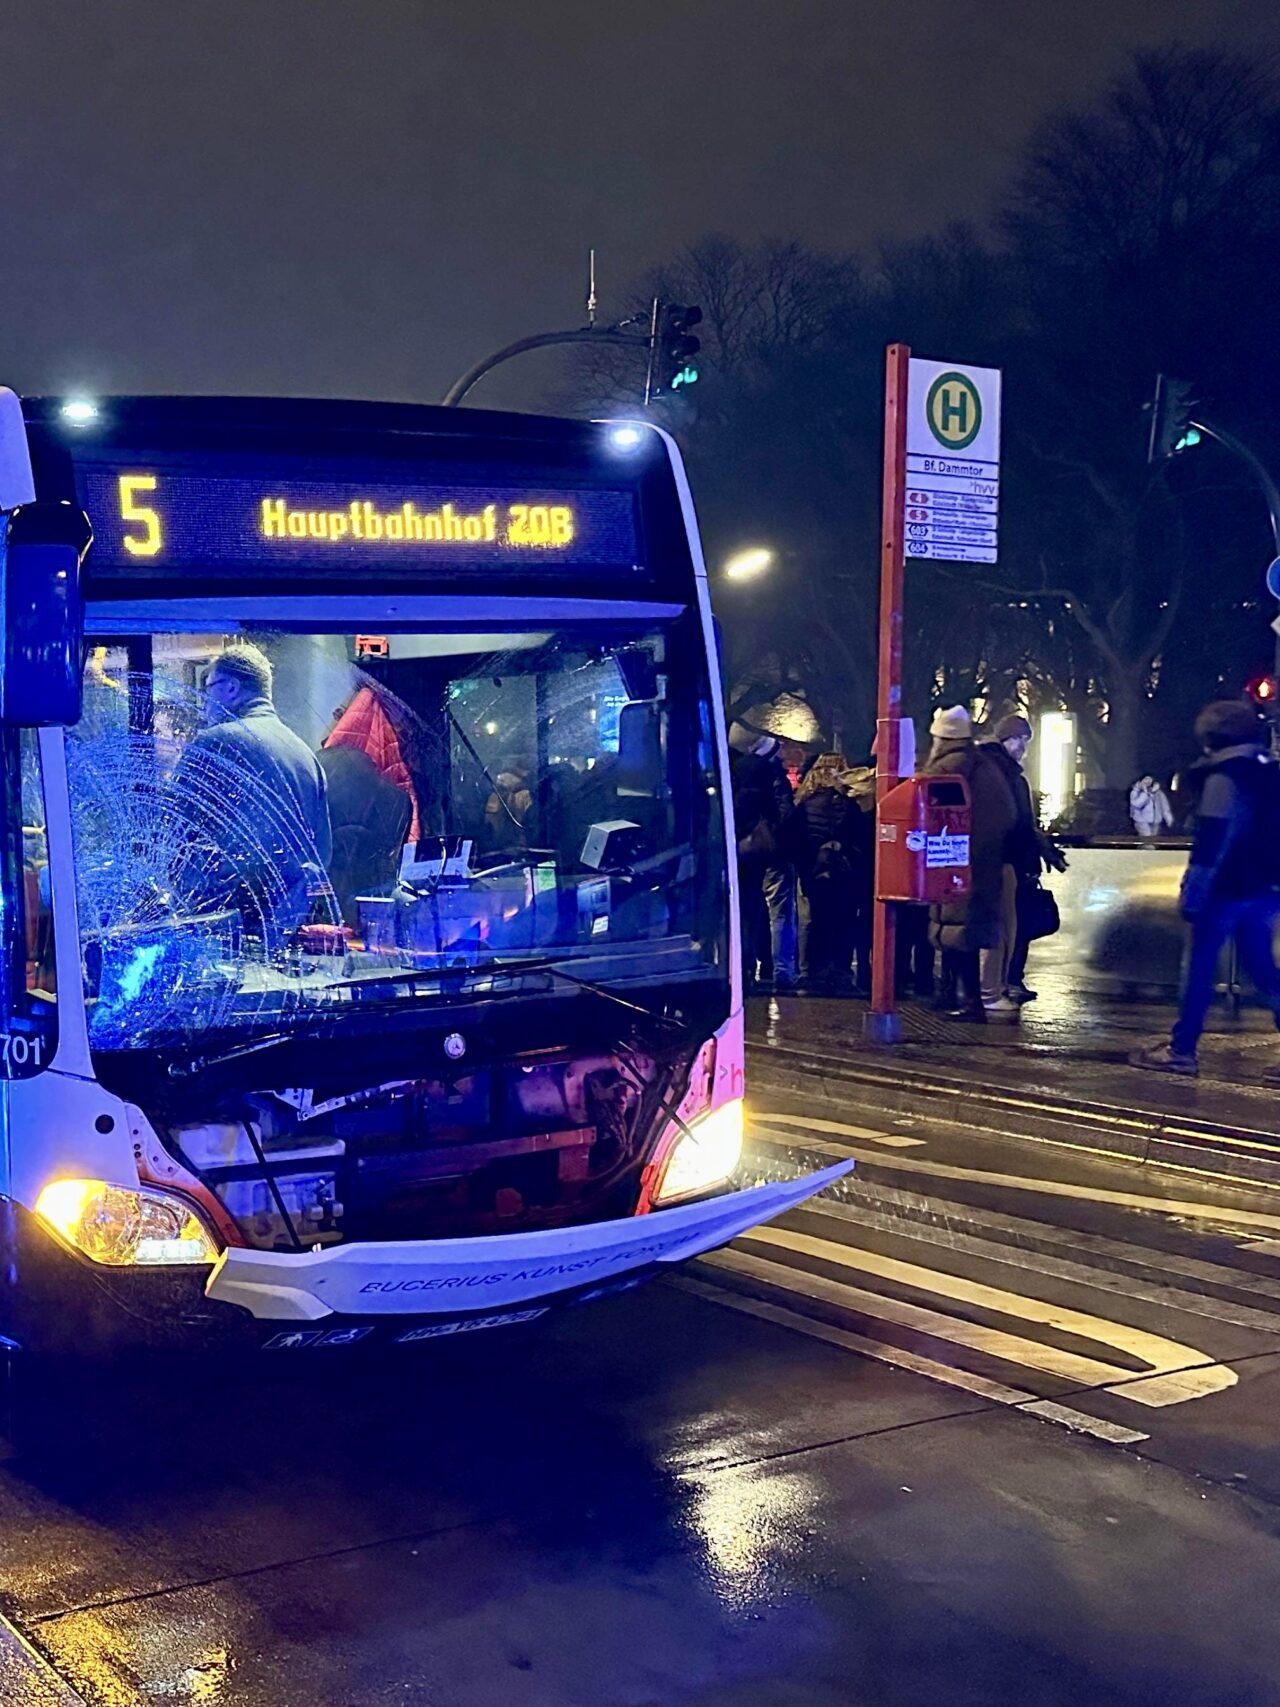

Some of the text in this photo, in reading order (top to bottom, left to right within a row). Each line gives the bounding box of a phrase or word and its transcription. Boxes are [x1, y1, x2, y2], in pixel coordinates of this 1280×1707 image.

[942, 388, 967, 433] H
[924, 460, 983, 476] Bf. Dammtor
[119, 475, 161, 556] 5
[261, 497, 495, 542] Hauptbahnhof
[359, 1273, 507, 1293] BUCERIUS
[512, 1256, 608, 1281] KUNST
